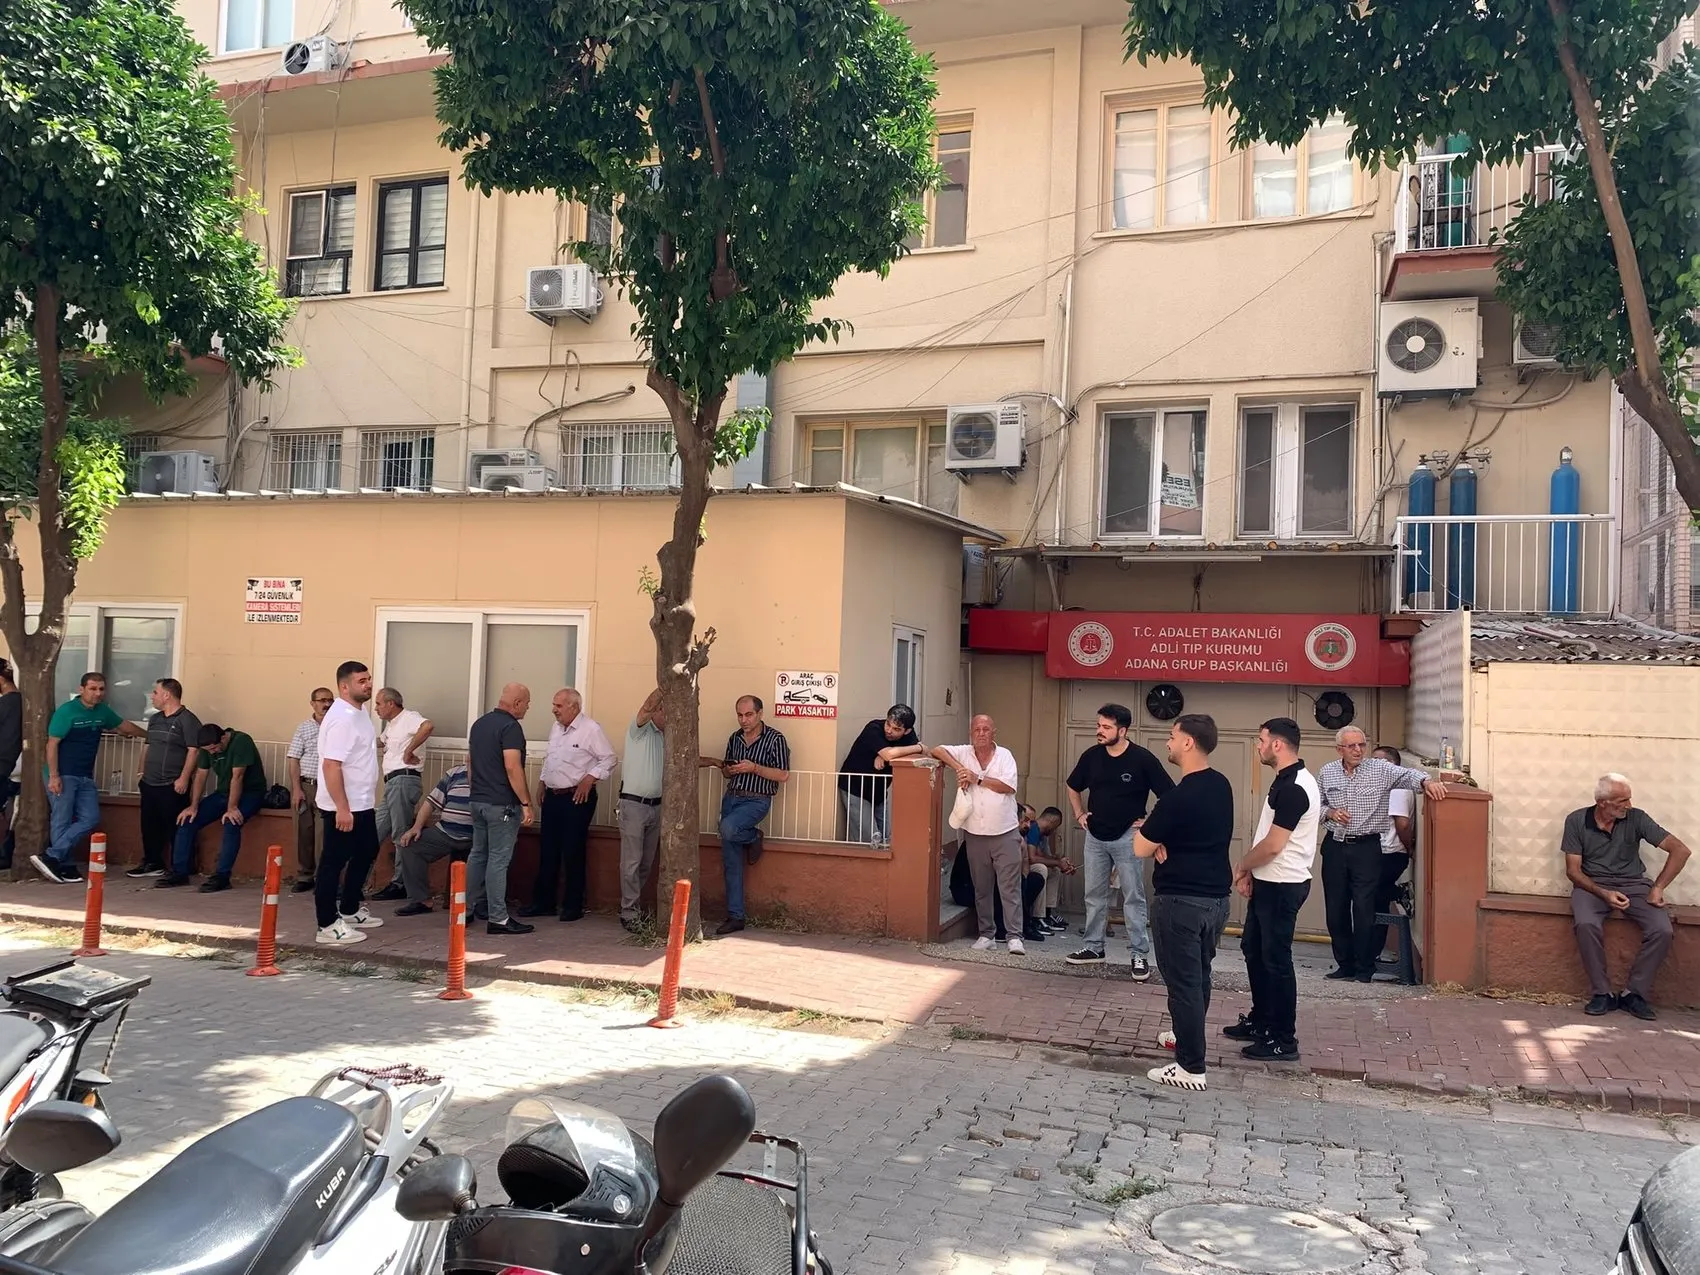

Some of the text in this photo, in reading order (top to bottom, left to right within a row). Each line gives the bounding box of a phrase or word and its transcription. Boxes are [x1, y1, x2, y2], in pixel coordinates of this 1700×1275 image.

[1133, 626, 1281, 639] T.C. ADALET BAKANLIĞI
[1150, 641, 1262, 655] ADLİ TIP KURUMU
[1125, 659, 1288, 673] ADANA GRUP BAŞKANLIĞI
[791, 679, 804, 687] GİRİŞ
[776, 705, 835, 716] PARK YASAKTIR
[315, 1166, 346, 1209] KUBA
